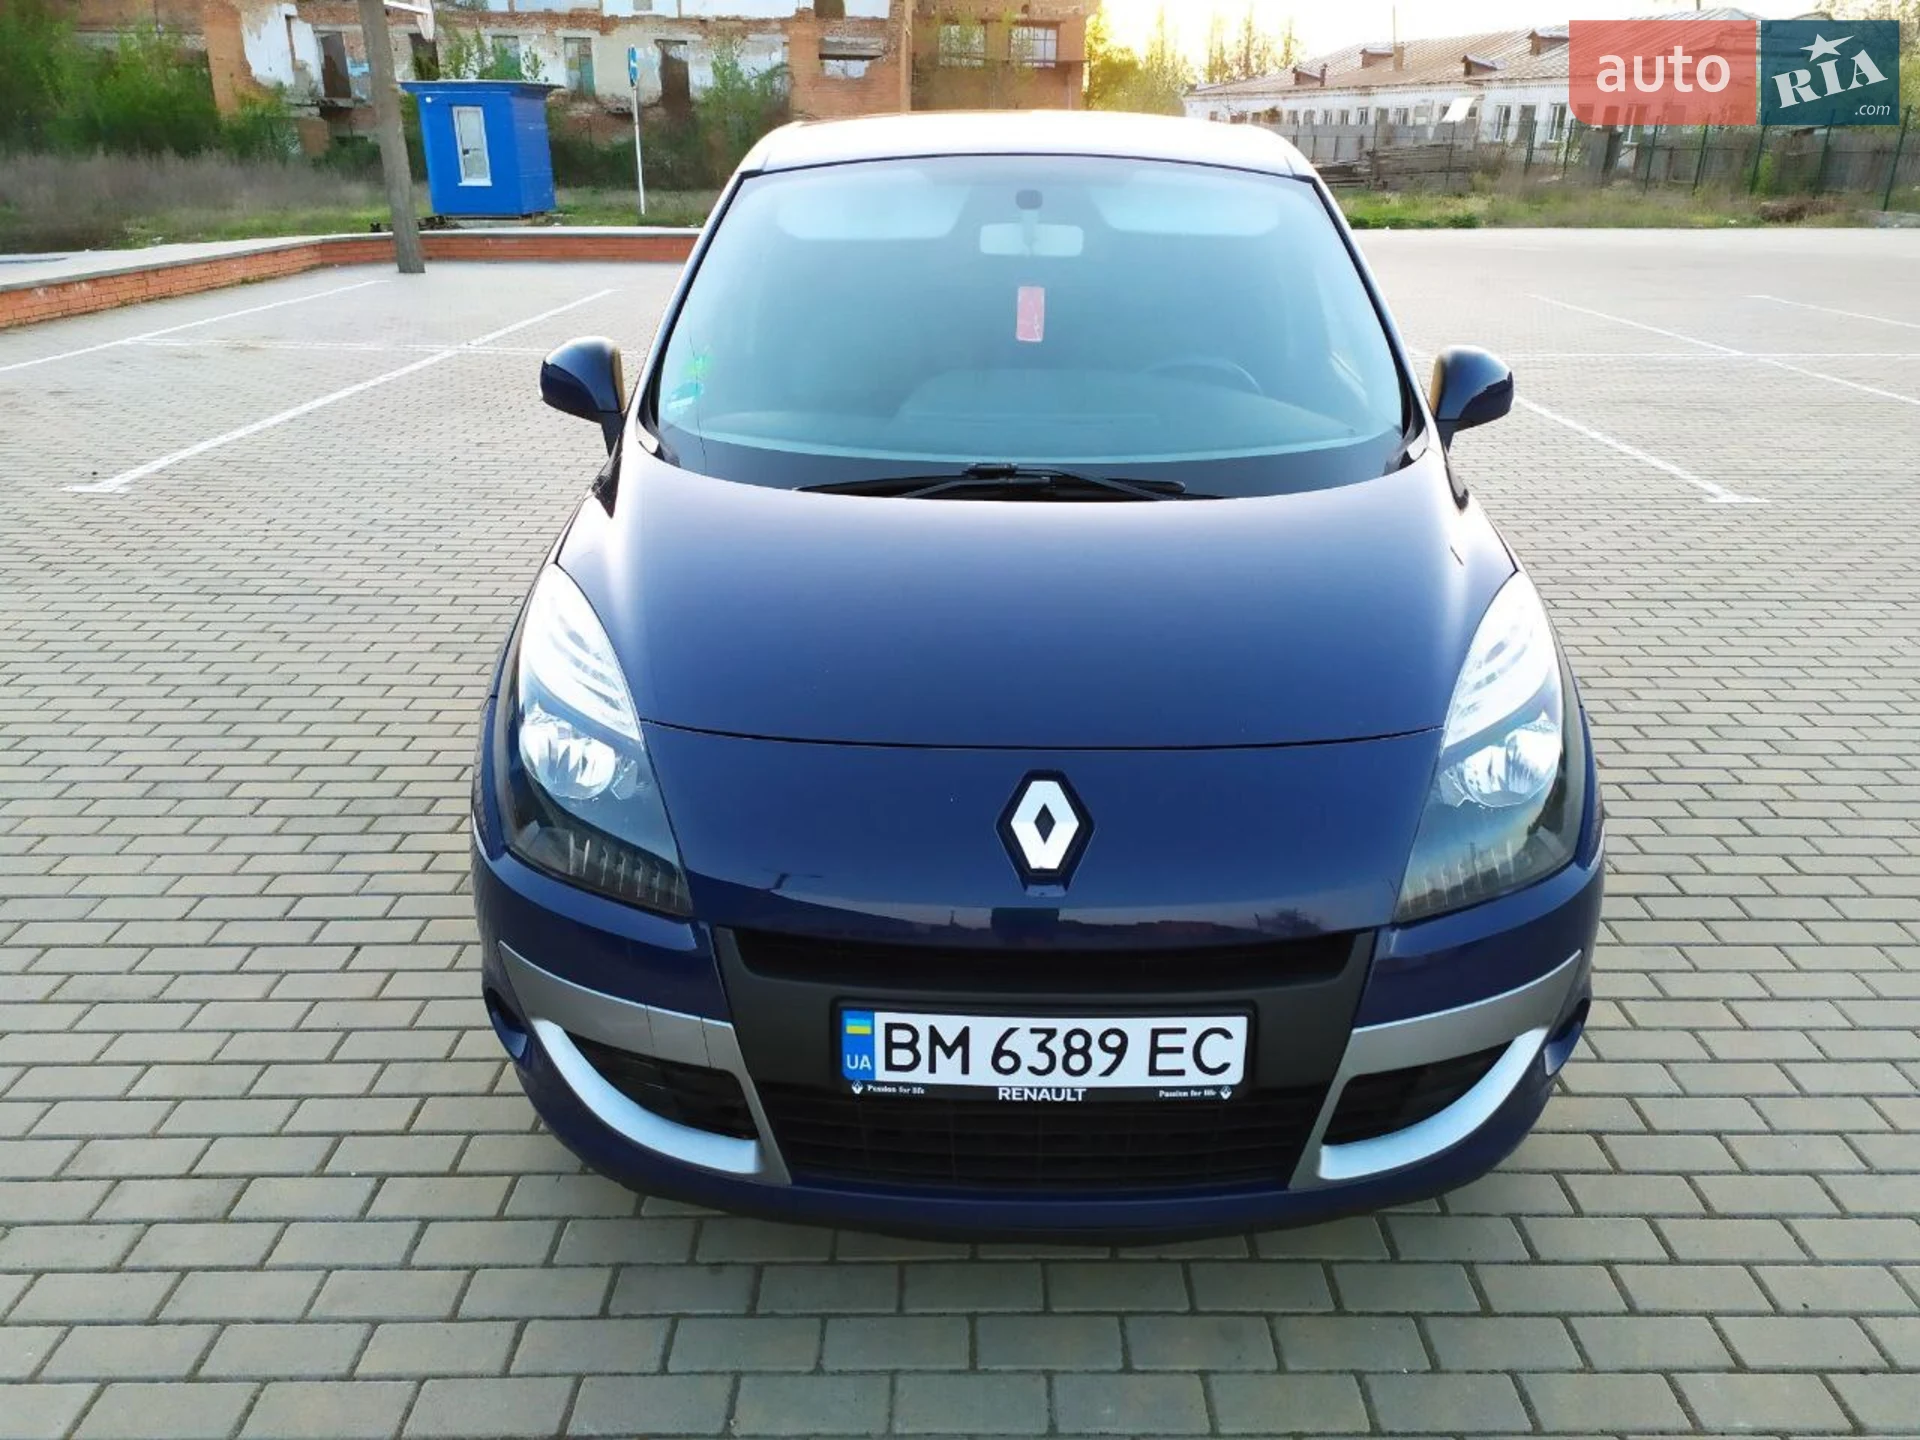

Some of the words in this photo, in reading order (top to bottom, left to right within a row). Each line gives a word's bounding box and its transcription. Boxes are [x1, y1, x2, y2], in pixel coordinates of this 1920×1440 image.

[883, 1022, 970, 1075] BM
[990, 1026, 1130, 1078] 6389
[1148, 1026, 1234, 1077] EC
[846, 1054, 872, 1072] UA
[998, 1086, 1087, 1102] RENAULT
